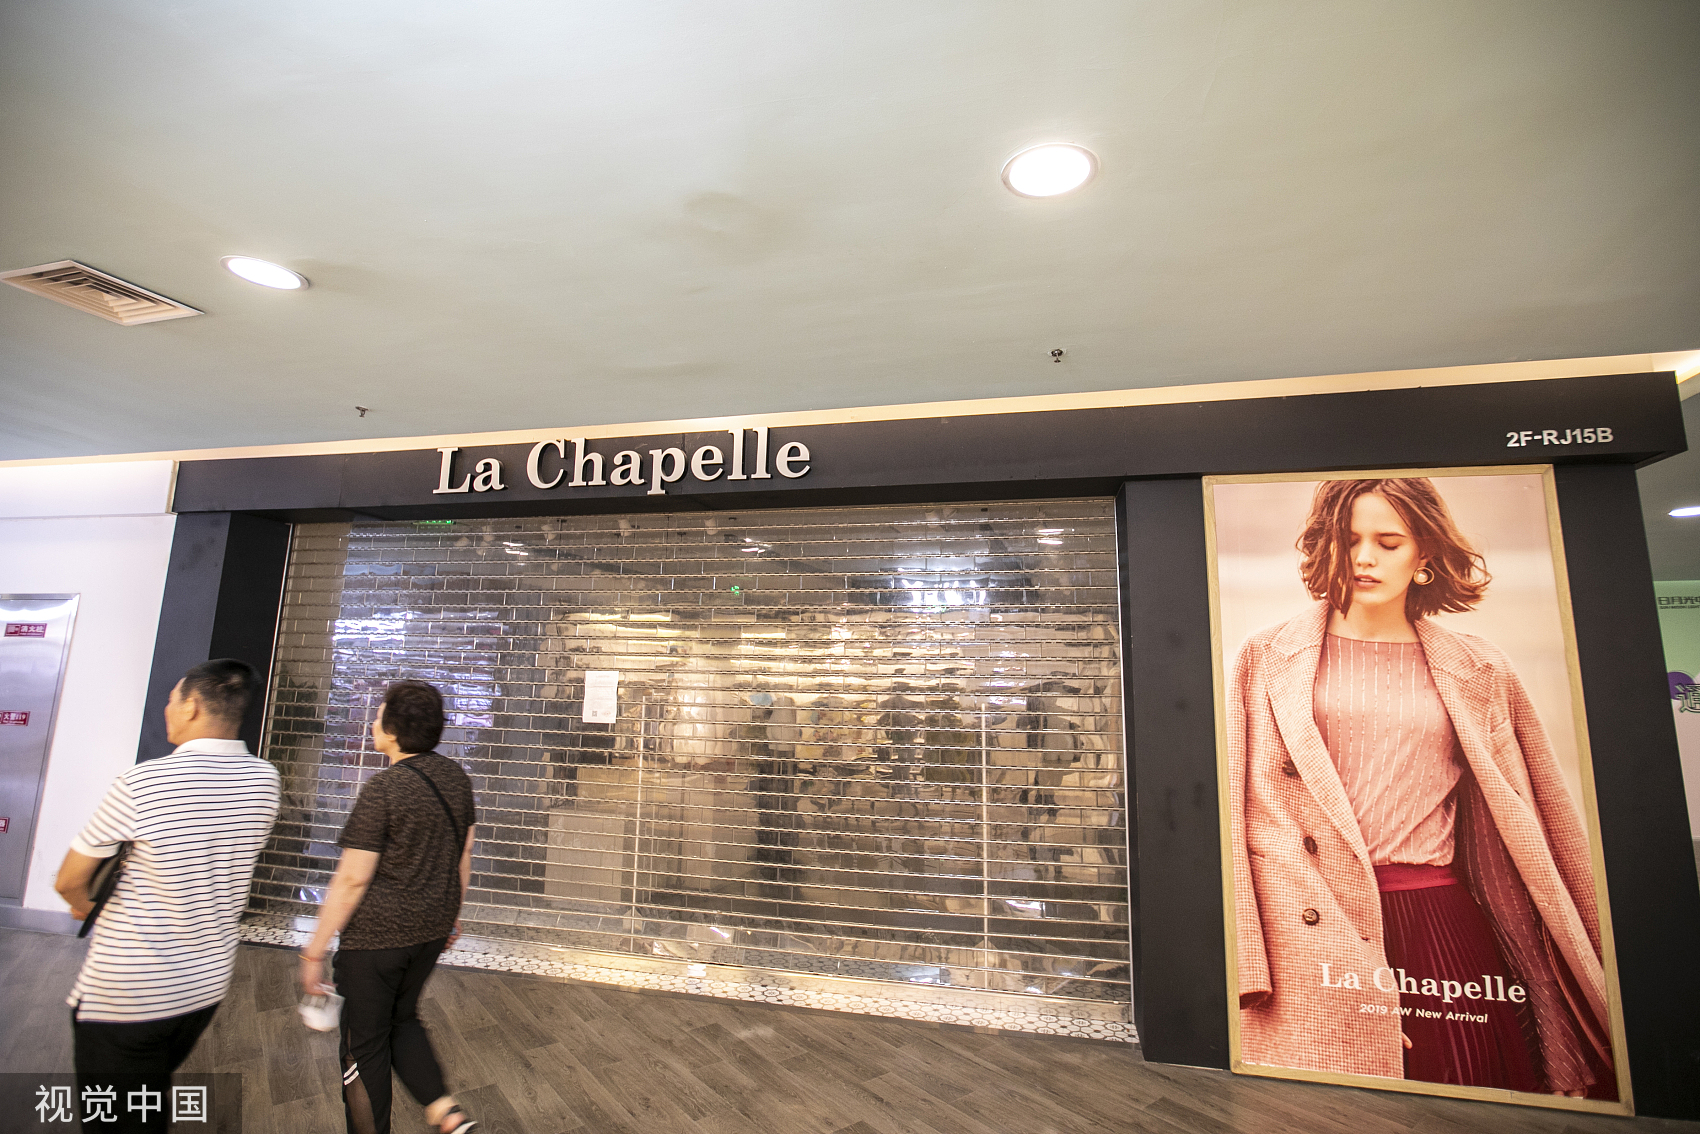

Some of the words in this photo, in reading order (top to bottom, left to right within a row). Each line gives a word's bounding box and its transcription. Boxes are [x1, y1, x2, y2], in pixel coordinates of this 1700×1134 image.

[1506, 427, 1614, 448] 2F-RJ15B
[432, 447, 506, 494] La
[526, 427, 812, 496] Chapelle
[1319, 962, 1362, 990] La
[1373, 967, 1527, 1004] Chapelle
[1359, 1003, 1388, 1014] 2019
[1392, 1006, 1413, 1017] AW
[1415, 1008, 1442, 1020] New
[1445, 1011, 1489, 1024] Arrival
